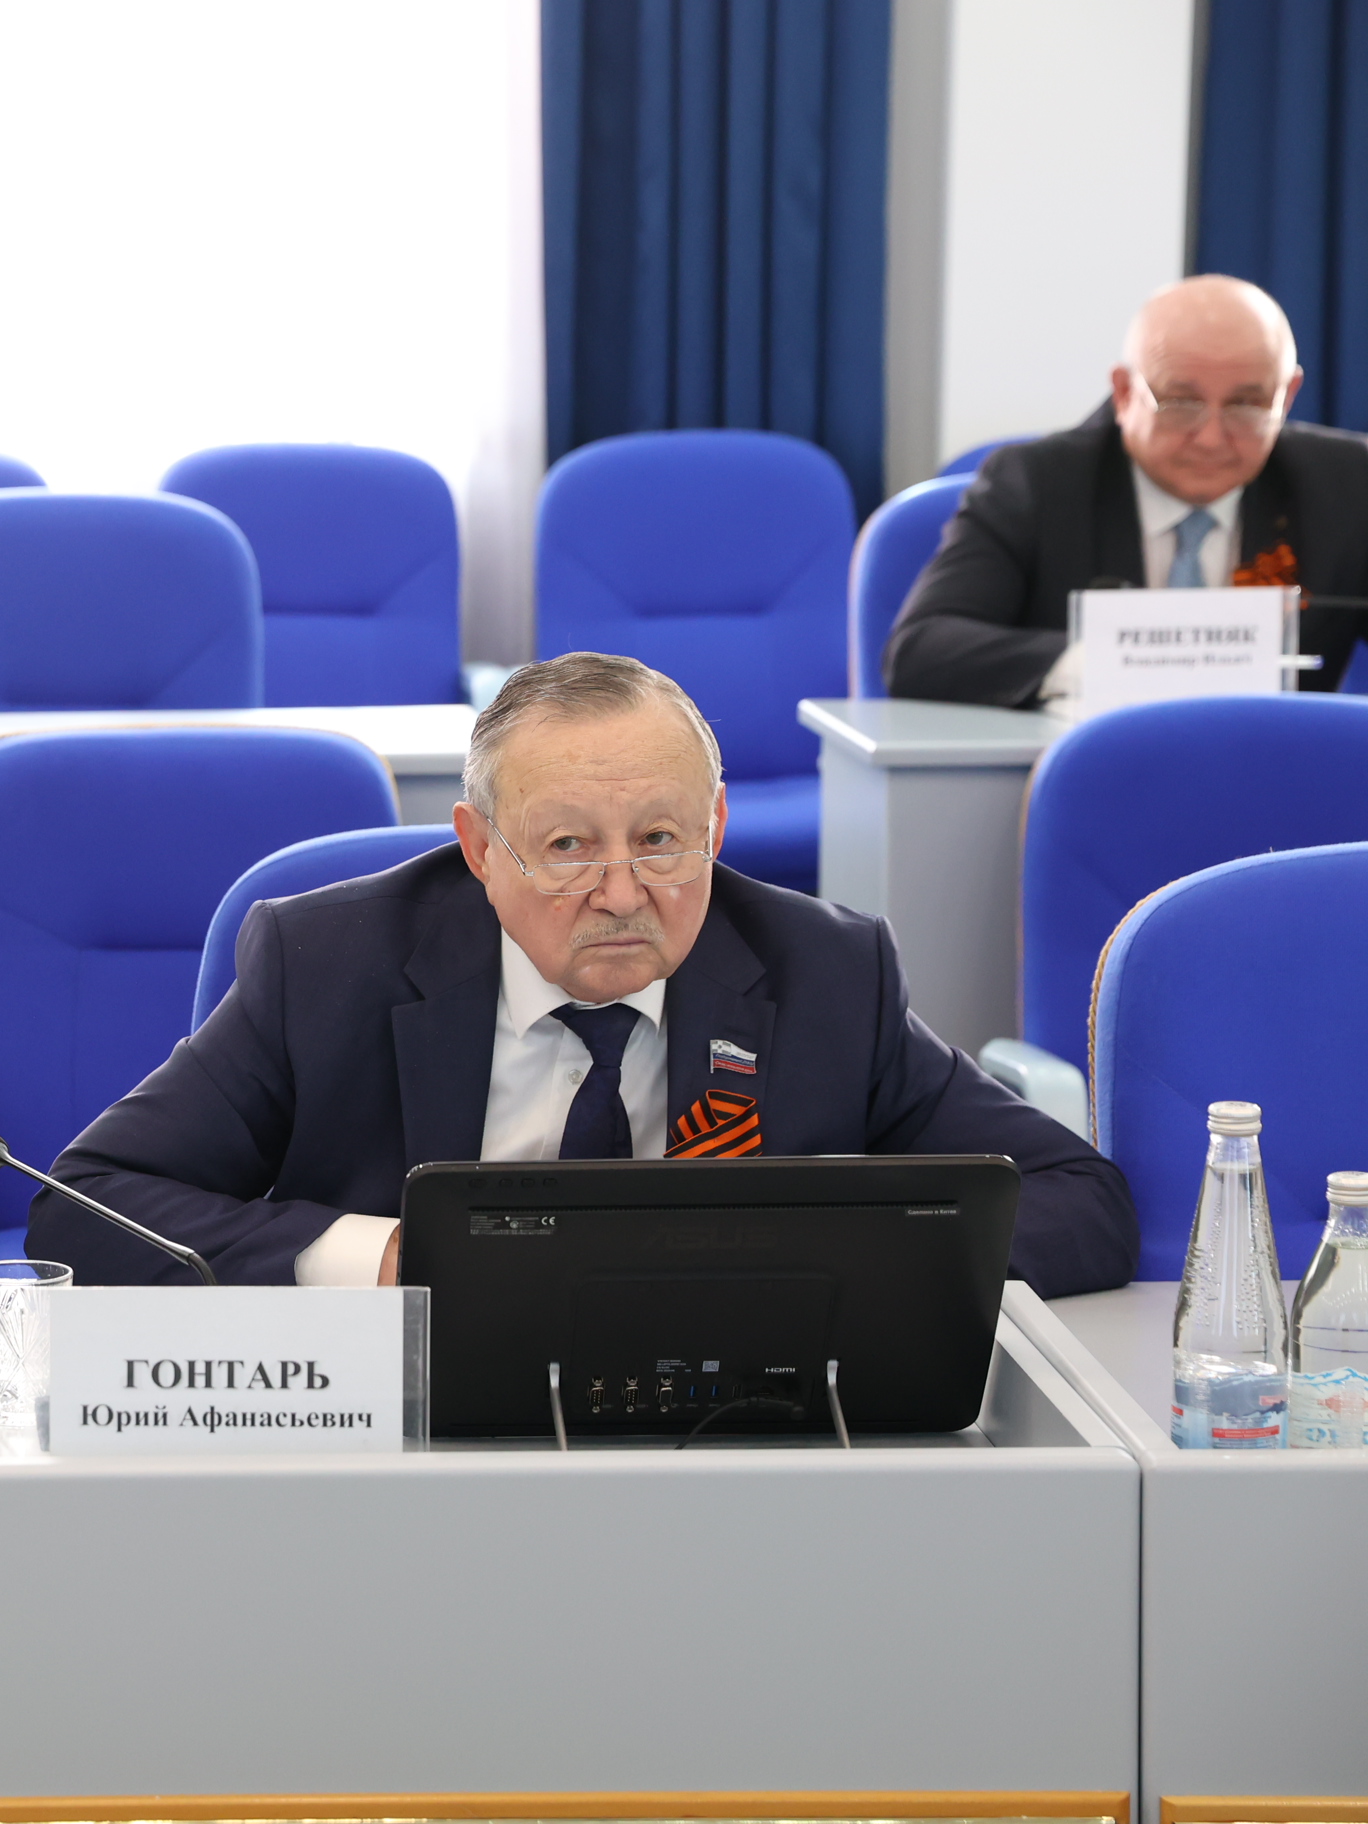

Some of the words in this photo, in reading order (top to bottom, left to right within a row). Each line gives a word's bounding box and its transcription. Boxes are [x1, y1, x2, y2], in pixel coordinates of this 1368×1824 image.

[541, 1216, 556, 1226] CE
[124, 1358, 331, 1390] ГОНТАРЬ
[80, 1403, 169, 1433] Юрий
[179, 1405, 373, 1433] Афанасьевич
